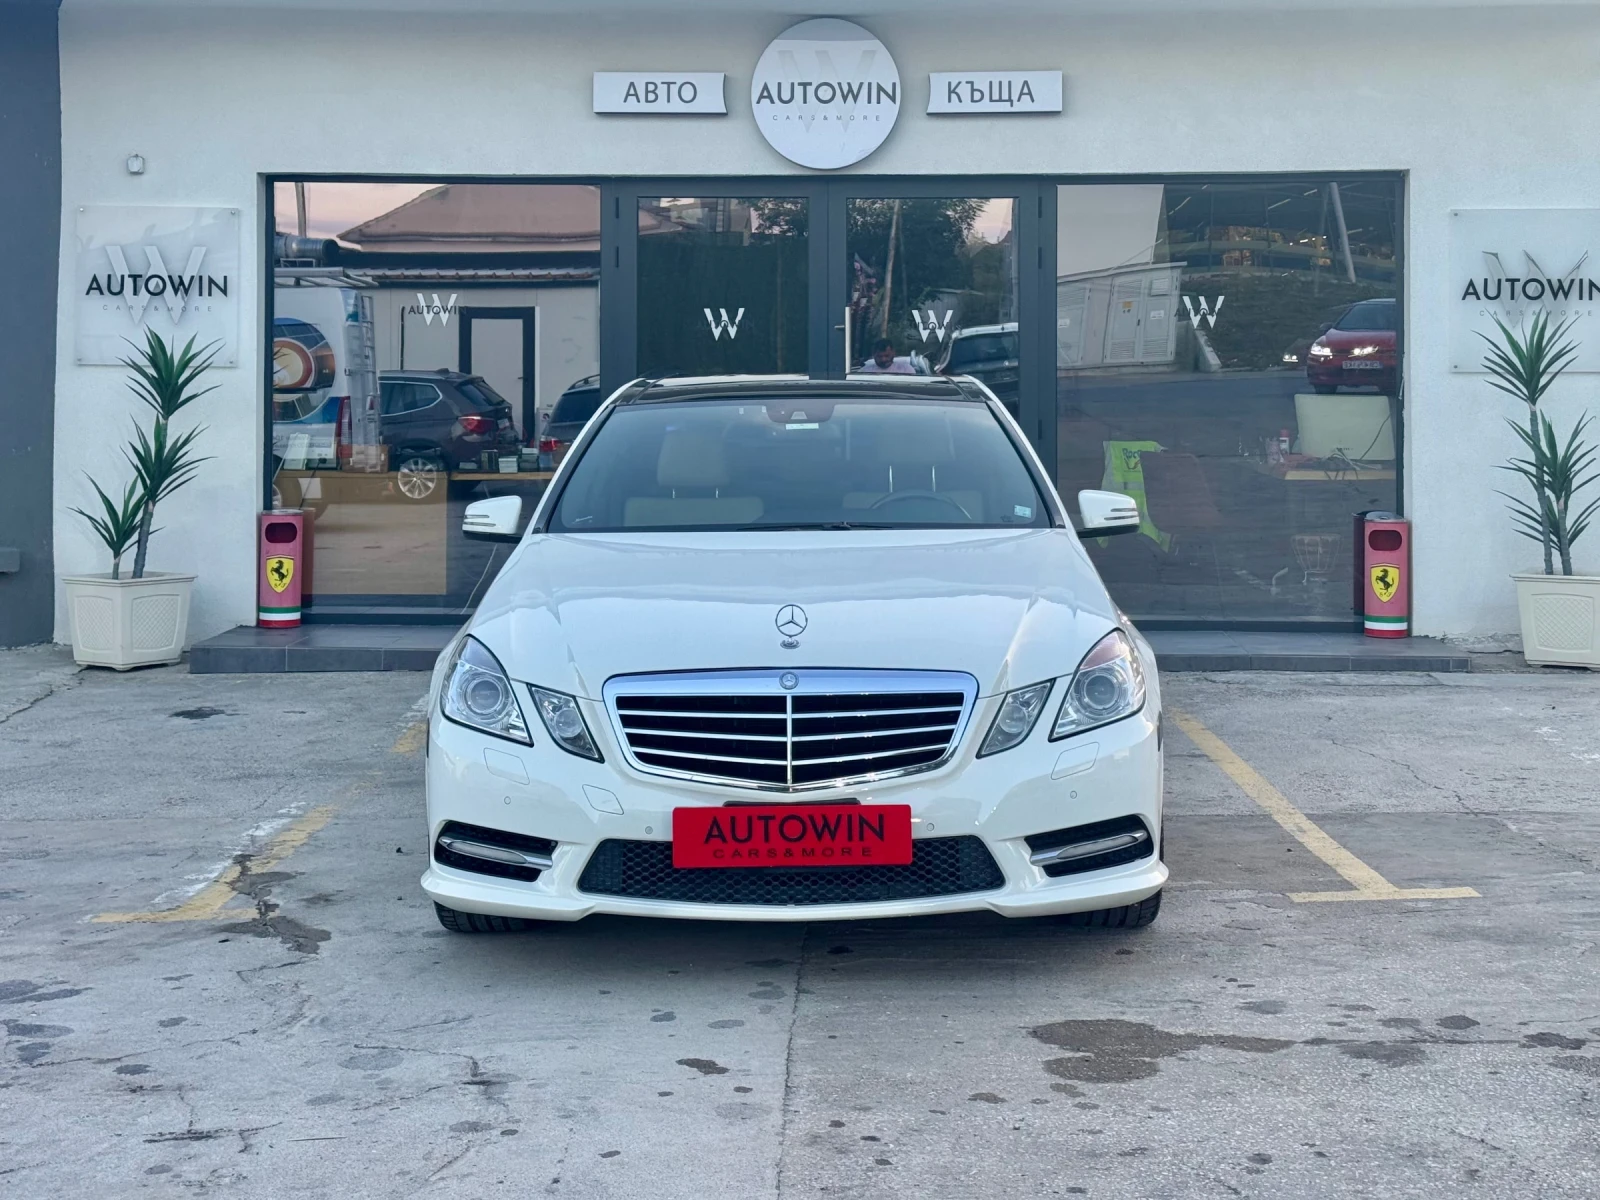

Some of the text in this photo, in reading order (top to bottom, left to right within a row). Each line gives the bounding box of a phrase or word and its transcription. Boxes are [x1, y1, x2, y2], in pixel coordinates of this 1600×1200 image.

[623, 81, 698, 104] АВТО
[756, 81, 897, 105] AUTOWIN
[947, 80, 1035, 108] КЪЩА
[772, 114, 881, 122] CARS&MORE
[85, 273, 228, 298] AUTOWIN
[102, 304, 212, 313] CARS&MORE
[704, 813, 885, 844] AUTOWIN
[713, 847, 873, 859] CARS&MORE
